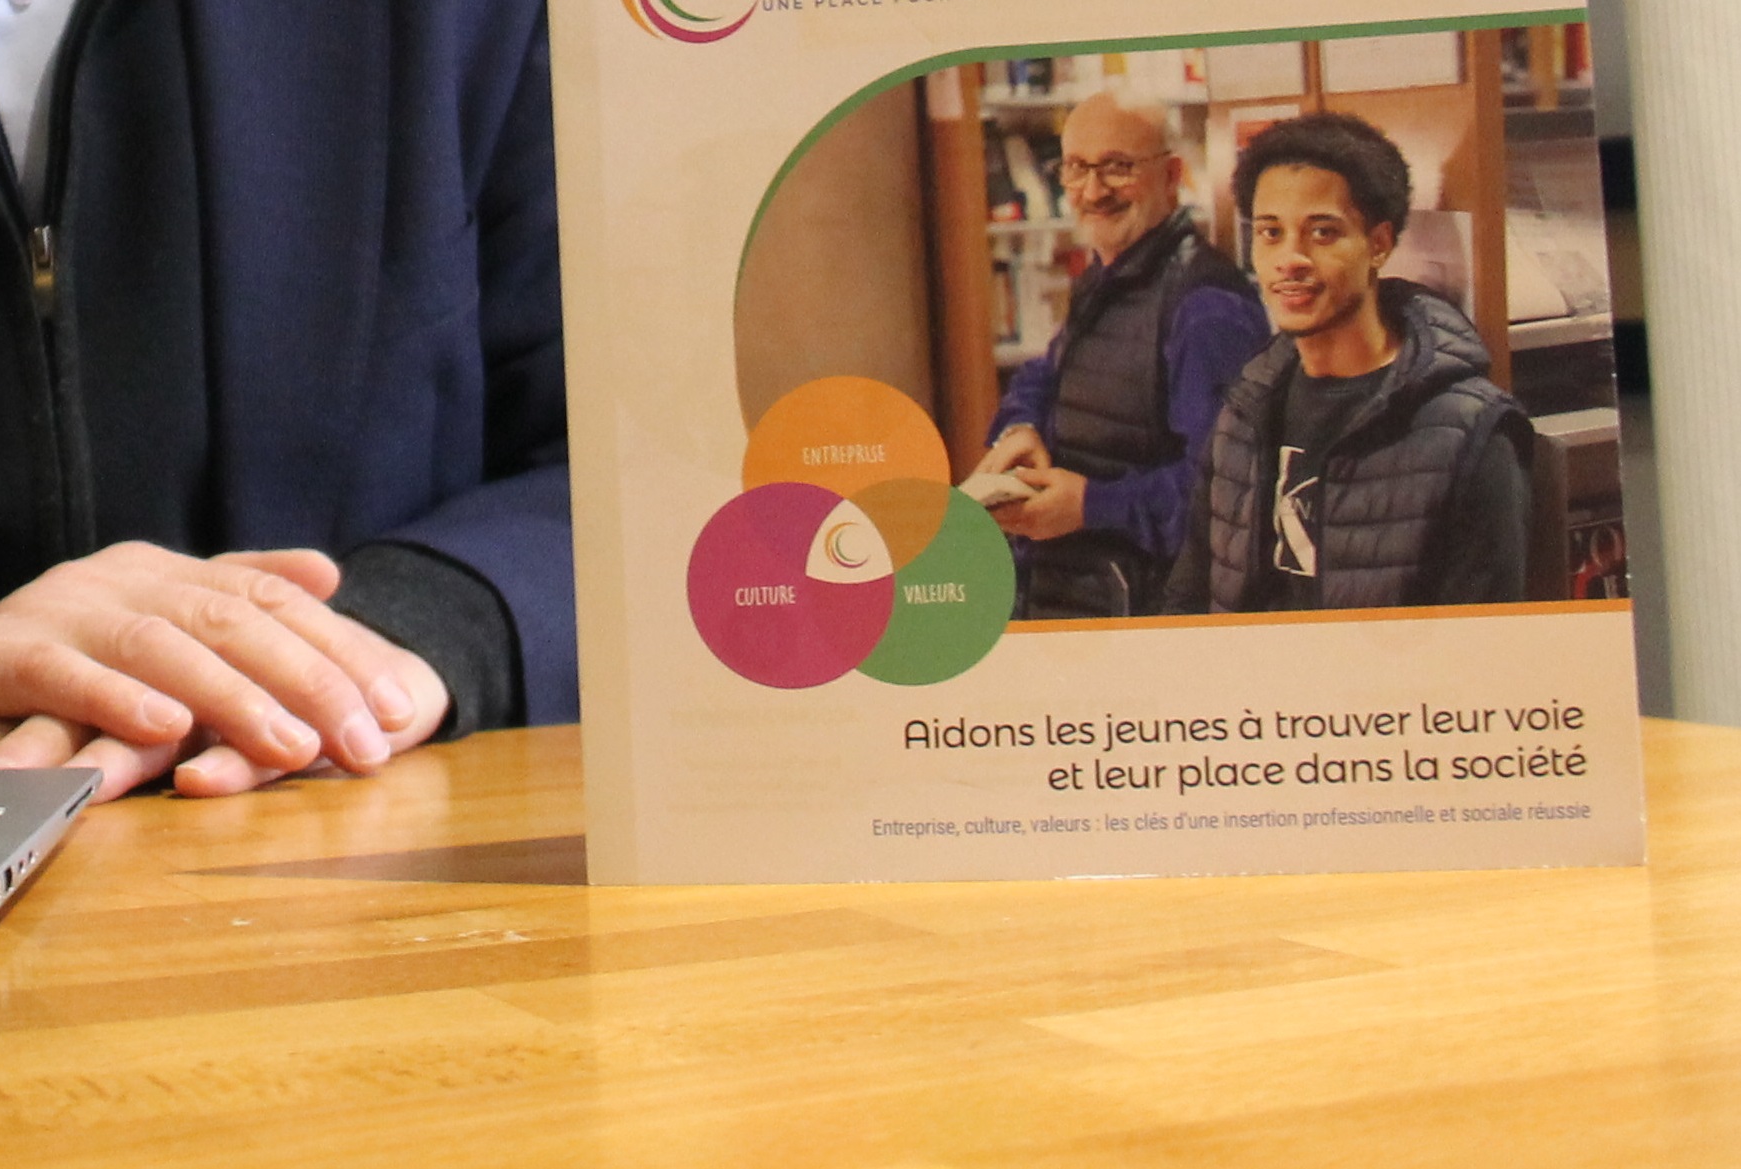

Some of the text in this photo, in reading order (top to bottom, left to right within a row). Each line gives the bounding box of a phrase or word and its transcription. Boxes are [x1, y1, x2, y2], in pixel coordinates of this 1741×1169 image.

[802, 444, 886, 465] ENTREPRISE
[735, 585, 797, 606] CULTURE
[903, 583, 966, 604] VALEURS
[904, 698, 1585, 753] Aidons les jeunes à trouver leur voie
[1047, 743, 1588, 796] et leur place dans la société
[871, 817, 961, 839] Entreprise,
[963, 814, 1027, 836] culture,
[1030, 814, 1092, 833] valeurs
[1104, 812, 1130, 832] les
[1133, 811, 1169, 831] clés
[1173, 810, 1220, 830] d'une
[1223, 808, 1298, 829] insertion
[1302, 804, 1436, 830] professionnelle
[1439, 806, 1458, 823] et
[1461, 802, 1523, 823] sociale
[1527, 800, 1592, 822] réussie
